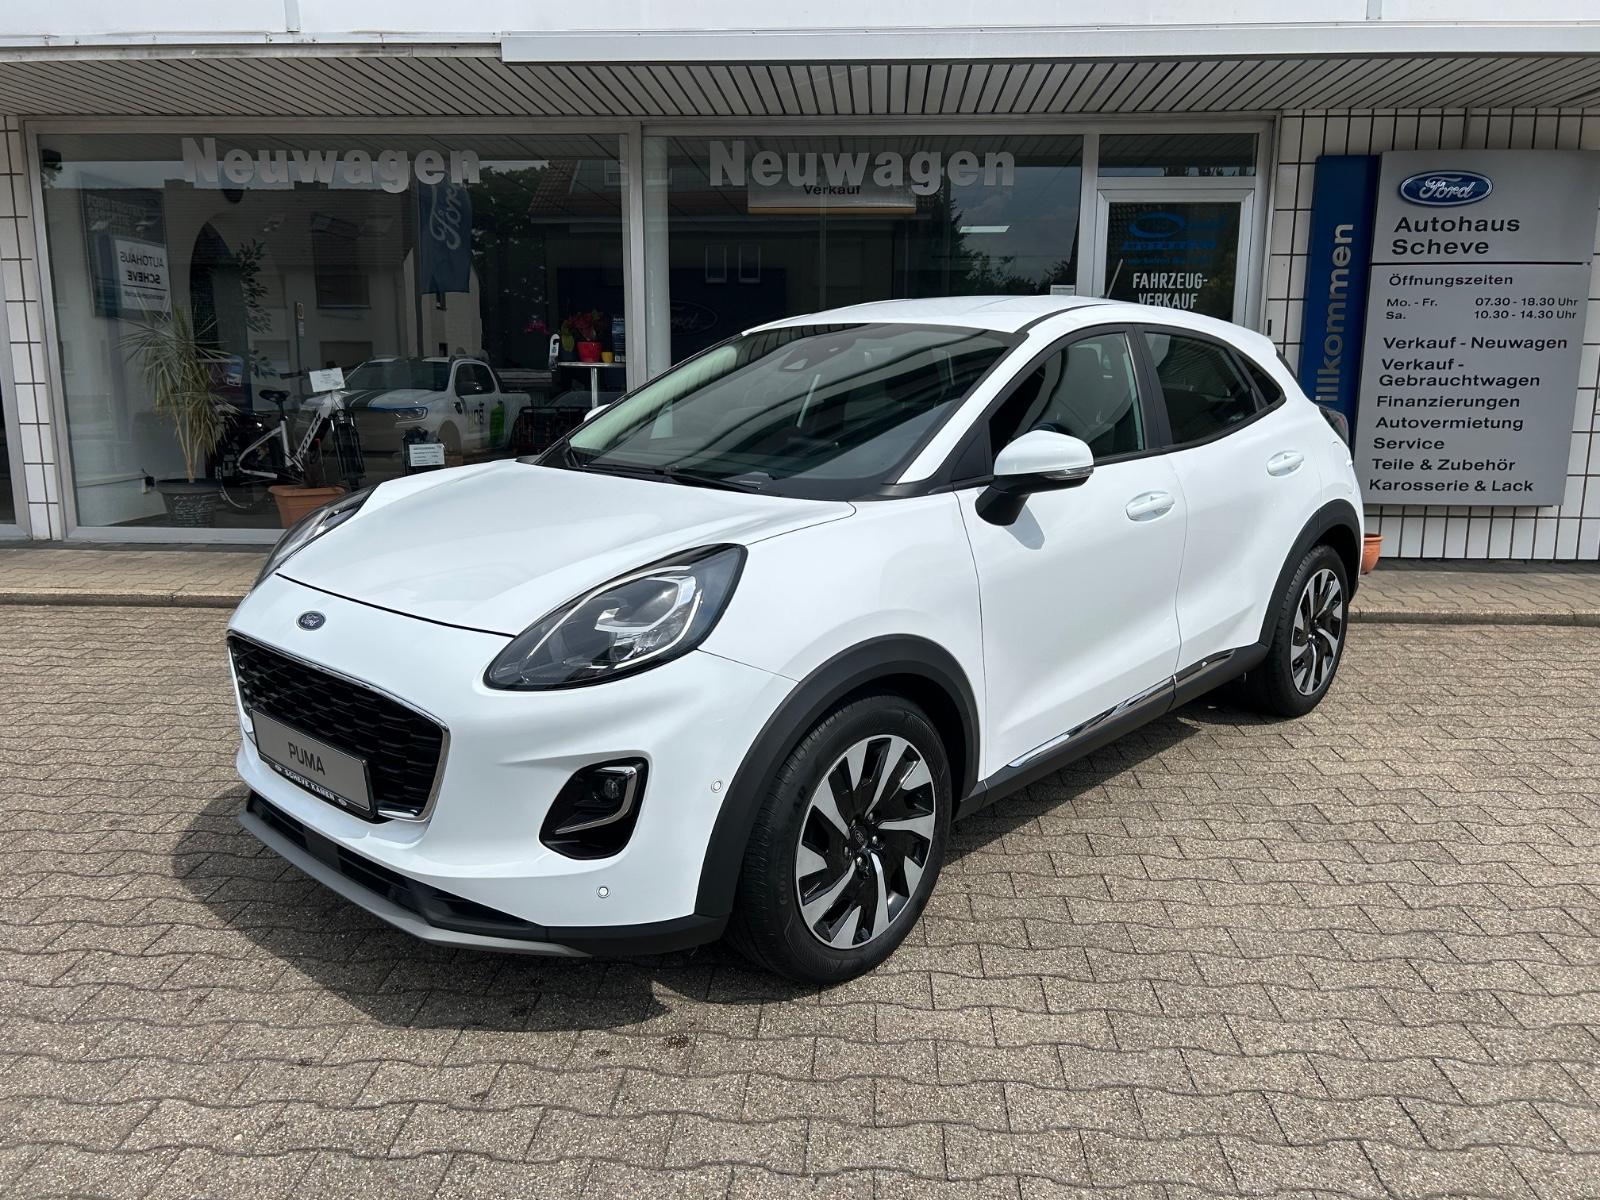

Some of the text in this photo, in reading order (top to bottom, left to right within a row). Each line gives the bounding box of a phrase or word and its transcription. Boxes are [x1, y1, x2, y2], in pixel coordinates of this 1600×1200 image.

[181, 137, 480, 194] Neuwagen
[709, 140, 1016, 196] Neuwagen
[802, 183, 863, 196] Verkauf
[1419, 176, 1476, 199] Ford
[429, 183, 461, 250] For
[1393, 215, 1521, 233] Autohaus
[1391, 238, 1490, 256] Scheve
[1132, 272, 1208, 289] FAHRZEUG-
[1389, 273, 1514, 288] Öffnungszeiten
[1386, 298, 1412, 308] Mo.
[1422, 298, 1438, 307] Fr.
[1475, 297, 1511, 307] 07.30
[1521, 297, 1555, 306] 18.30
[1558, 297, 1579, 307] Uhr
[1315, 222, 1355, 402] illkommen
[1385, 311, 1407, 320] Sa.
[1474, 310, 1509, 319] 10.30
[1520, 310, 1553, 319] 14.30
[1556, 310, 1577, 319] Uhr
[1383, 337, 1457, 350] Verkauf
[1470, 336, 1568, 352] Neuwagen
[1381, 358, 1455, 371] Verkauf
[1378, 374, 1541, 389] Gebrauchtwagen
[1376, 396, 1521, 410] Finanzierungen
[1375, 417, 1524, 432] Autovermietung
[1373, 437, 1446, 450] Service
[1372, 458, 1516, 472] Teile & Zubehör
[1369, 478, 1535, 493] Karosserie & Lack
[288, 741, 326, 776] PUMA
